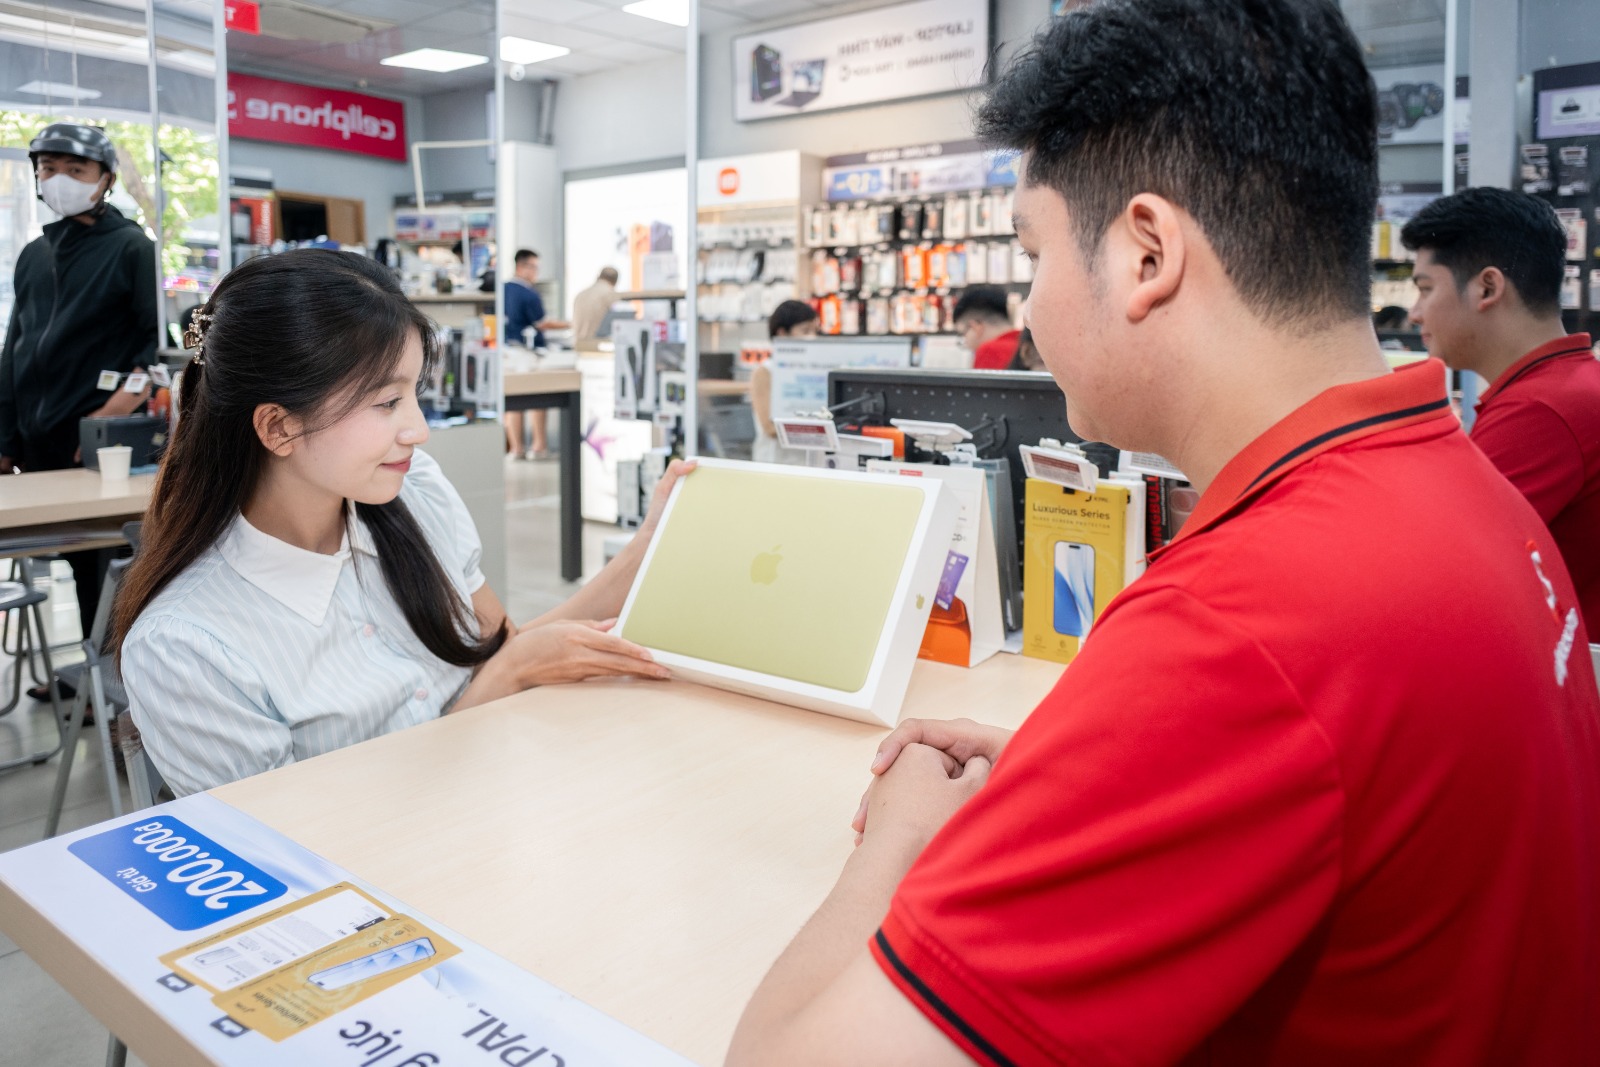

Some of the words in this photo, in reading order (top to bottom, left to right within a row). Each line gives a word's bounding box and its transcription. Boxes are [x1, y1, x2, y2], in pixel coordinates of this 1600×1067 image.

[1032, 503, 1078, 516] Luxurious
[1080, 508, 1110, 520] Series
[132, 821, 269, 910] 200.000đ
